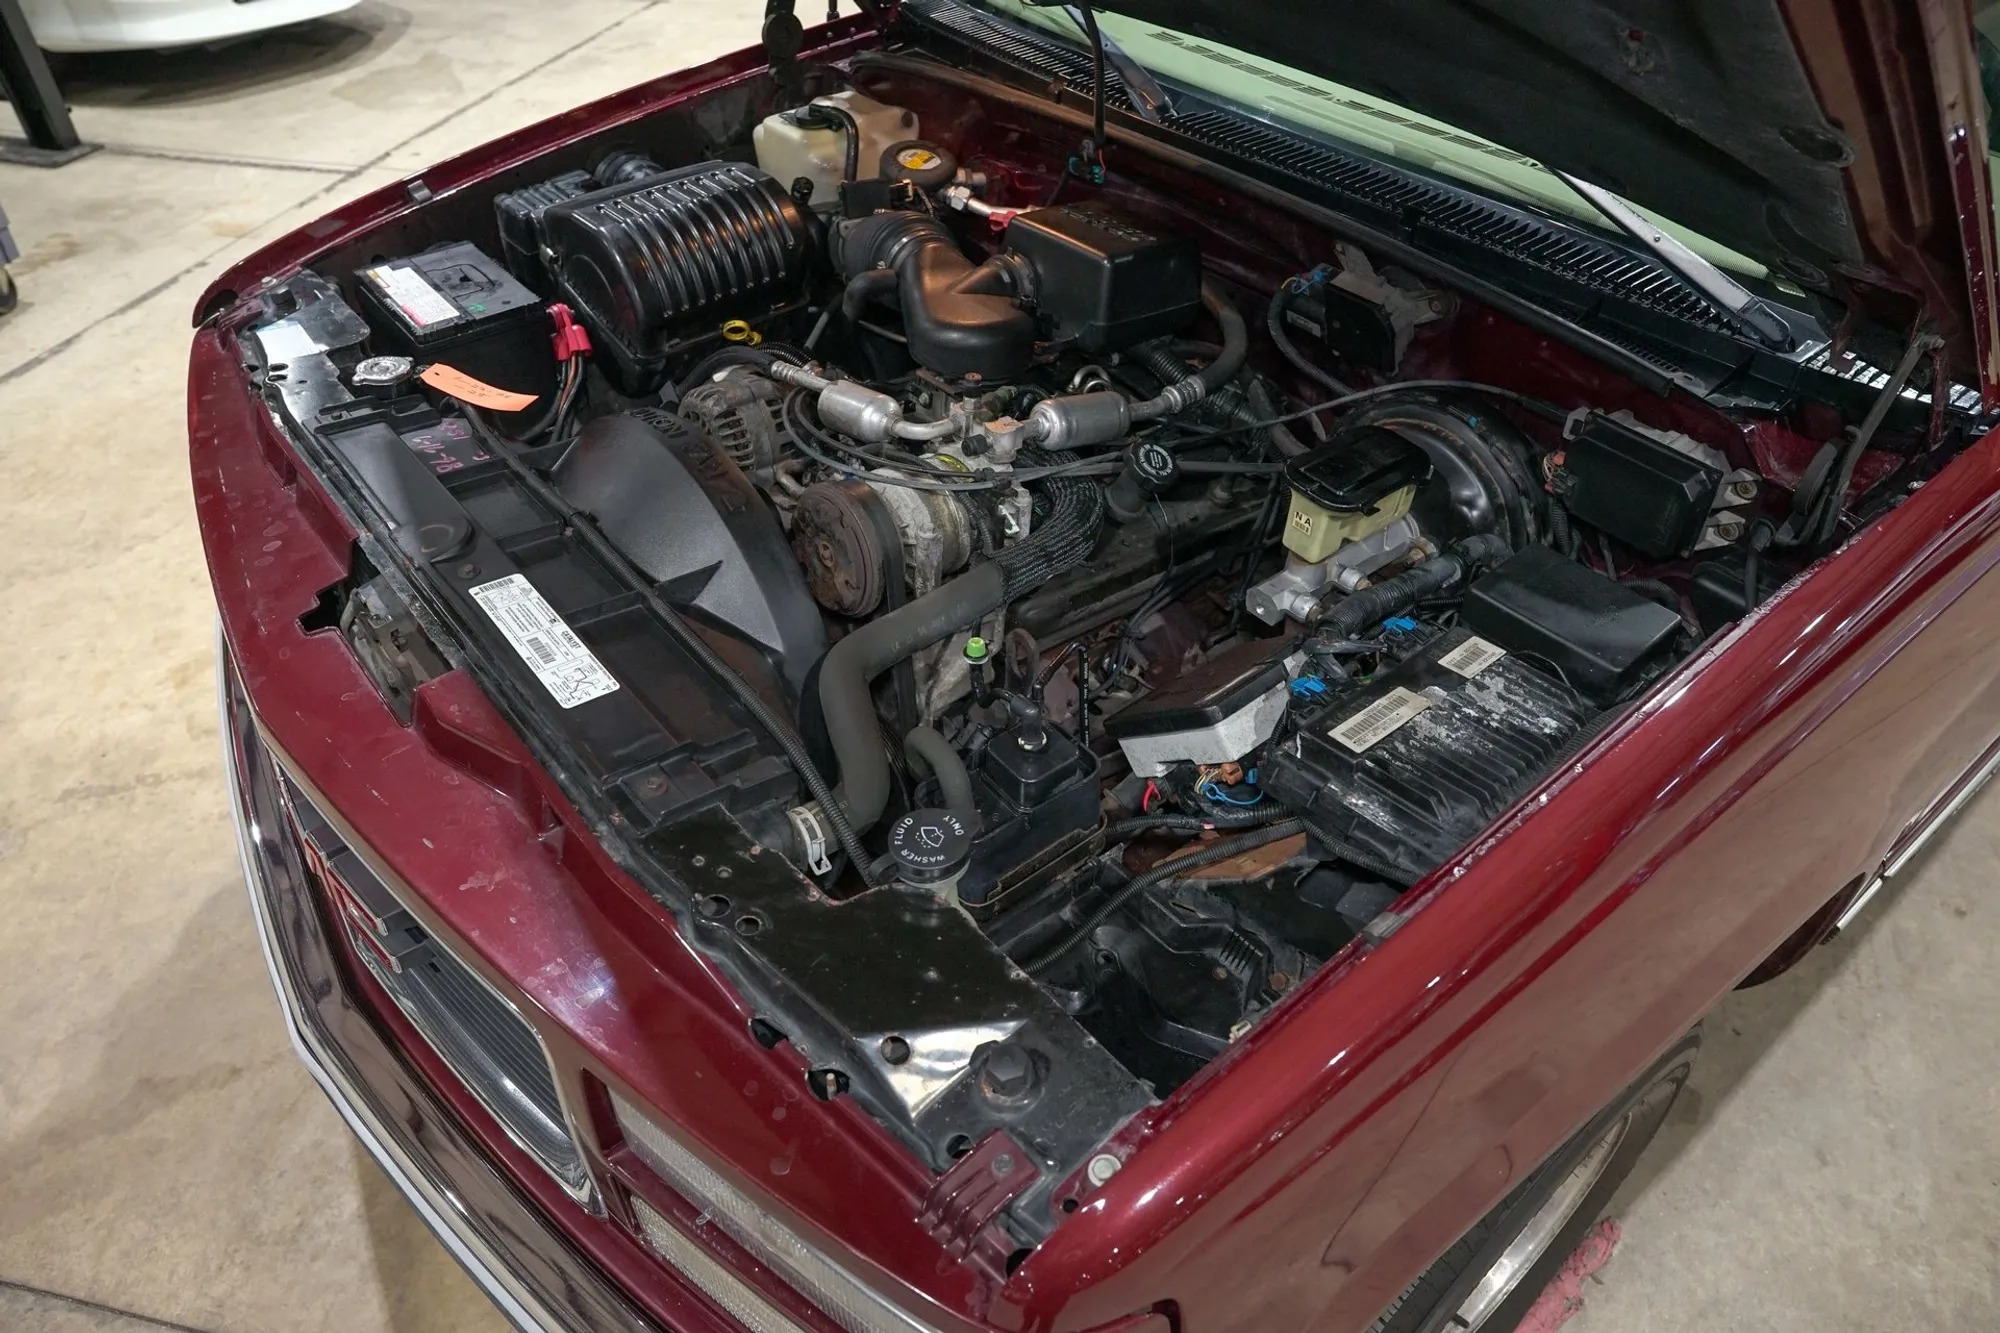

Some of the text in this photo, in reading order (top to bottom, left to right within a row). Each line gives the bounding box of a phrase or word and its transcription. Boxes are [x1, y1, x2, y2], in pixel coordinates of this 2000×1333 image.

[561, 630, 582, 650] CATALYST
[894, 815, 965, 863] WASHER FLUID ONLY
